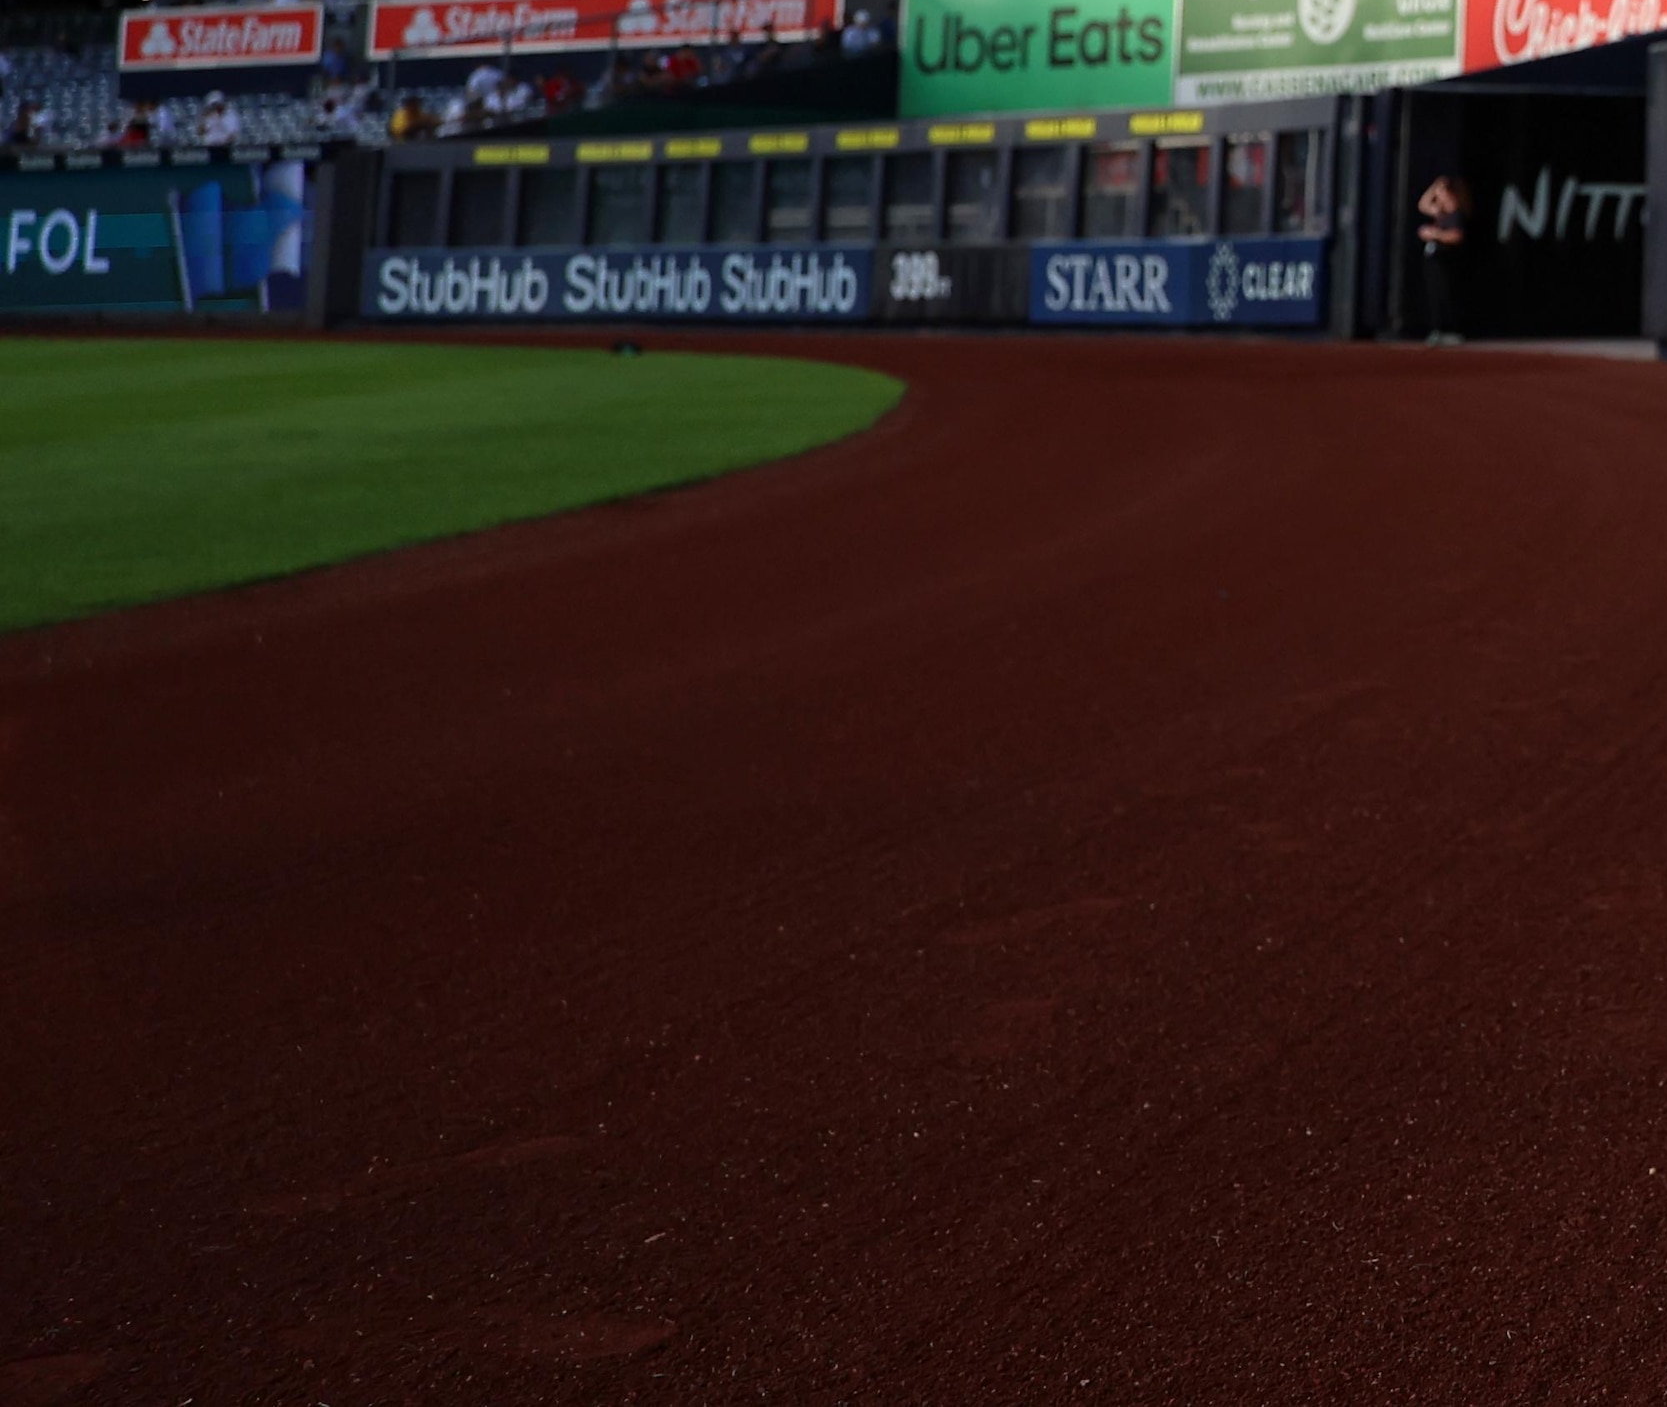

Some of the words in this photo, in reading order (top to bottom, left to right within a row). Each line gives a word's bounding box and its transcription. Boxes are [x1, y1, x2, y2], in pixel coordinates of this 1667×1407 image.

[914, 13, 1036, 75] Uber
[1049, 5, 1165, 67] Eats
[1498, 164, 1649, 242] NITT
[378, 256, 548, 313] StubHub
[564, 255, 712, 312] StubHub
[722, 252, 857, 312] StubHub
[1044, 253, 1173, 313] STARR
[1241, 261, 1316, 301] CLEAR
